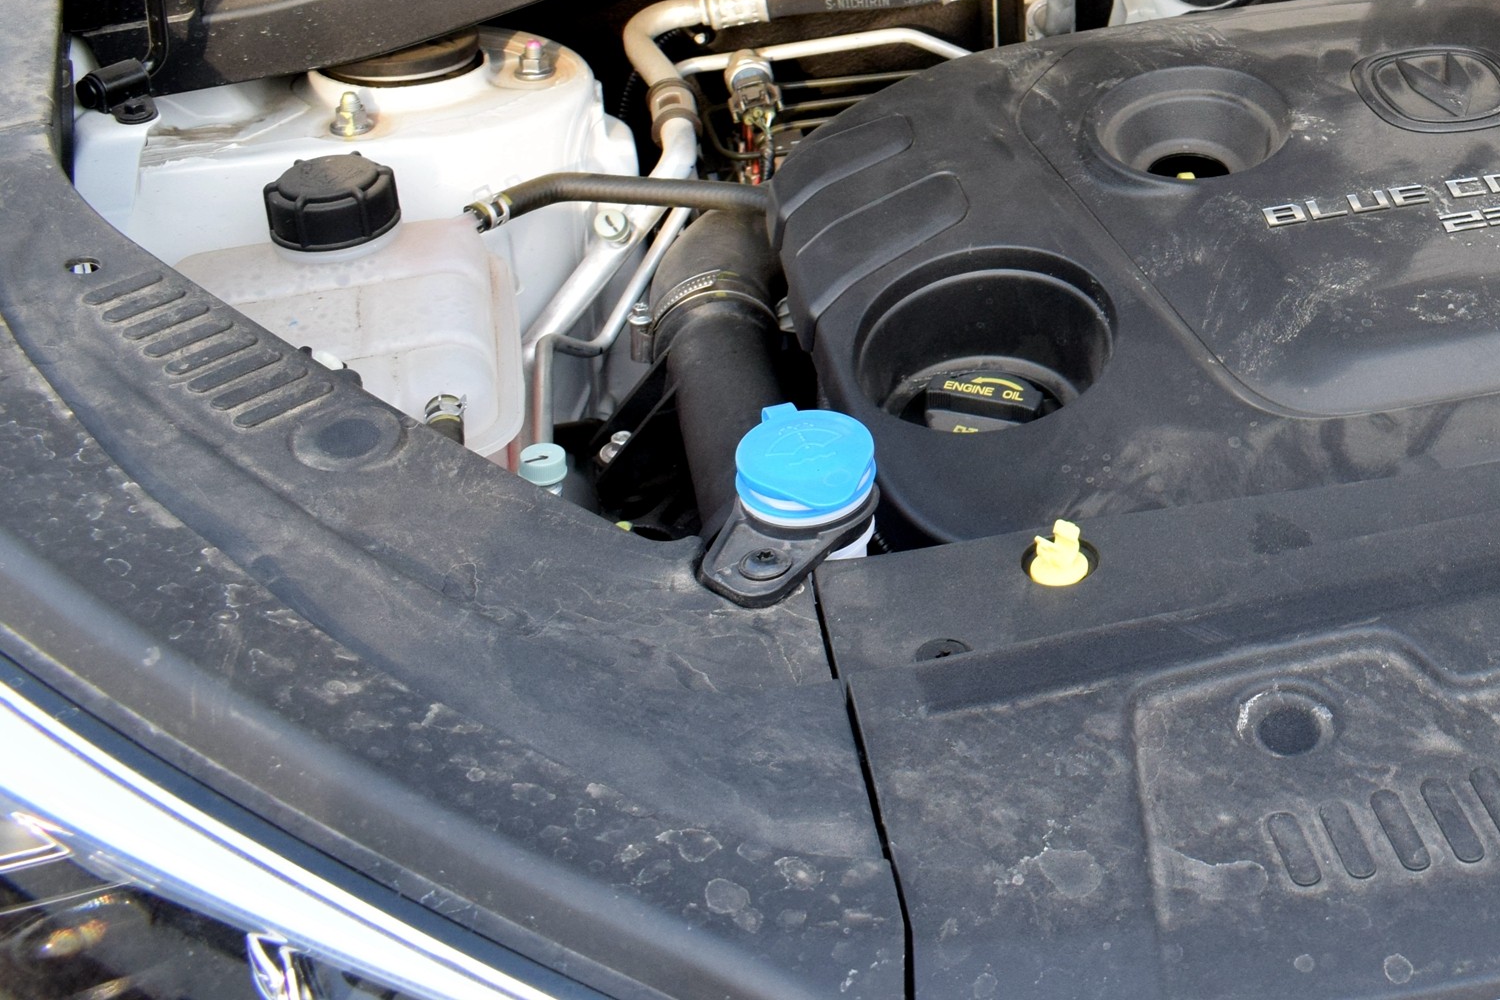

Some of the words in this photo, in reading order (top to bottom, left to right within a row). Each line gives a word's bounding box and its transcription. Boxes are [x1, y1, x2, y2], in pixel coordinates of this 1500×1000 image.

[1262, 184, 1430, 228] BLUE
[944, 380, 995, 396] ENGINE
[1003, 390, 1024, 401] OIL
